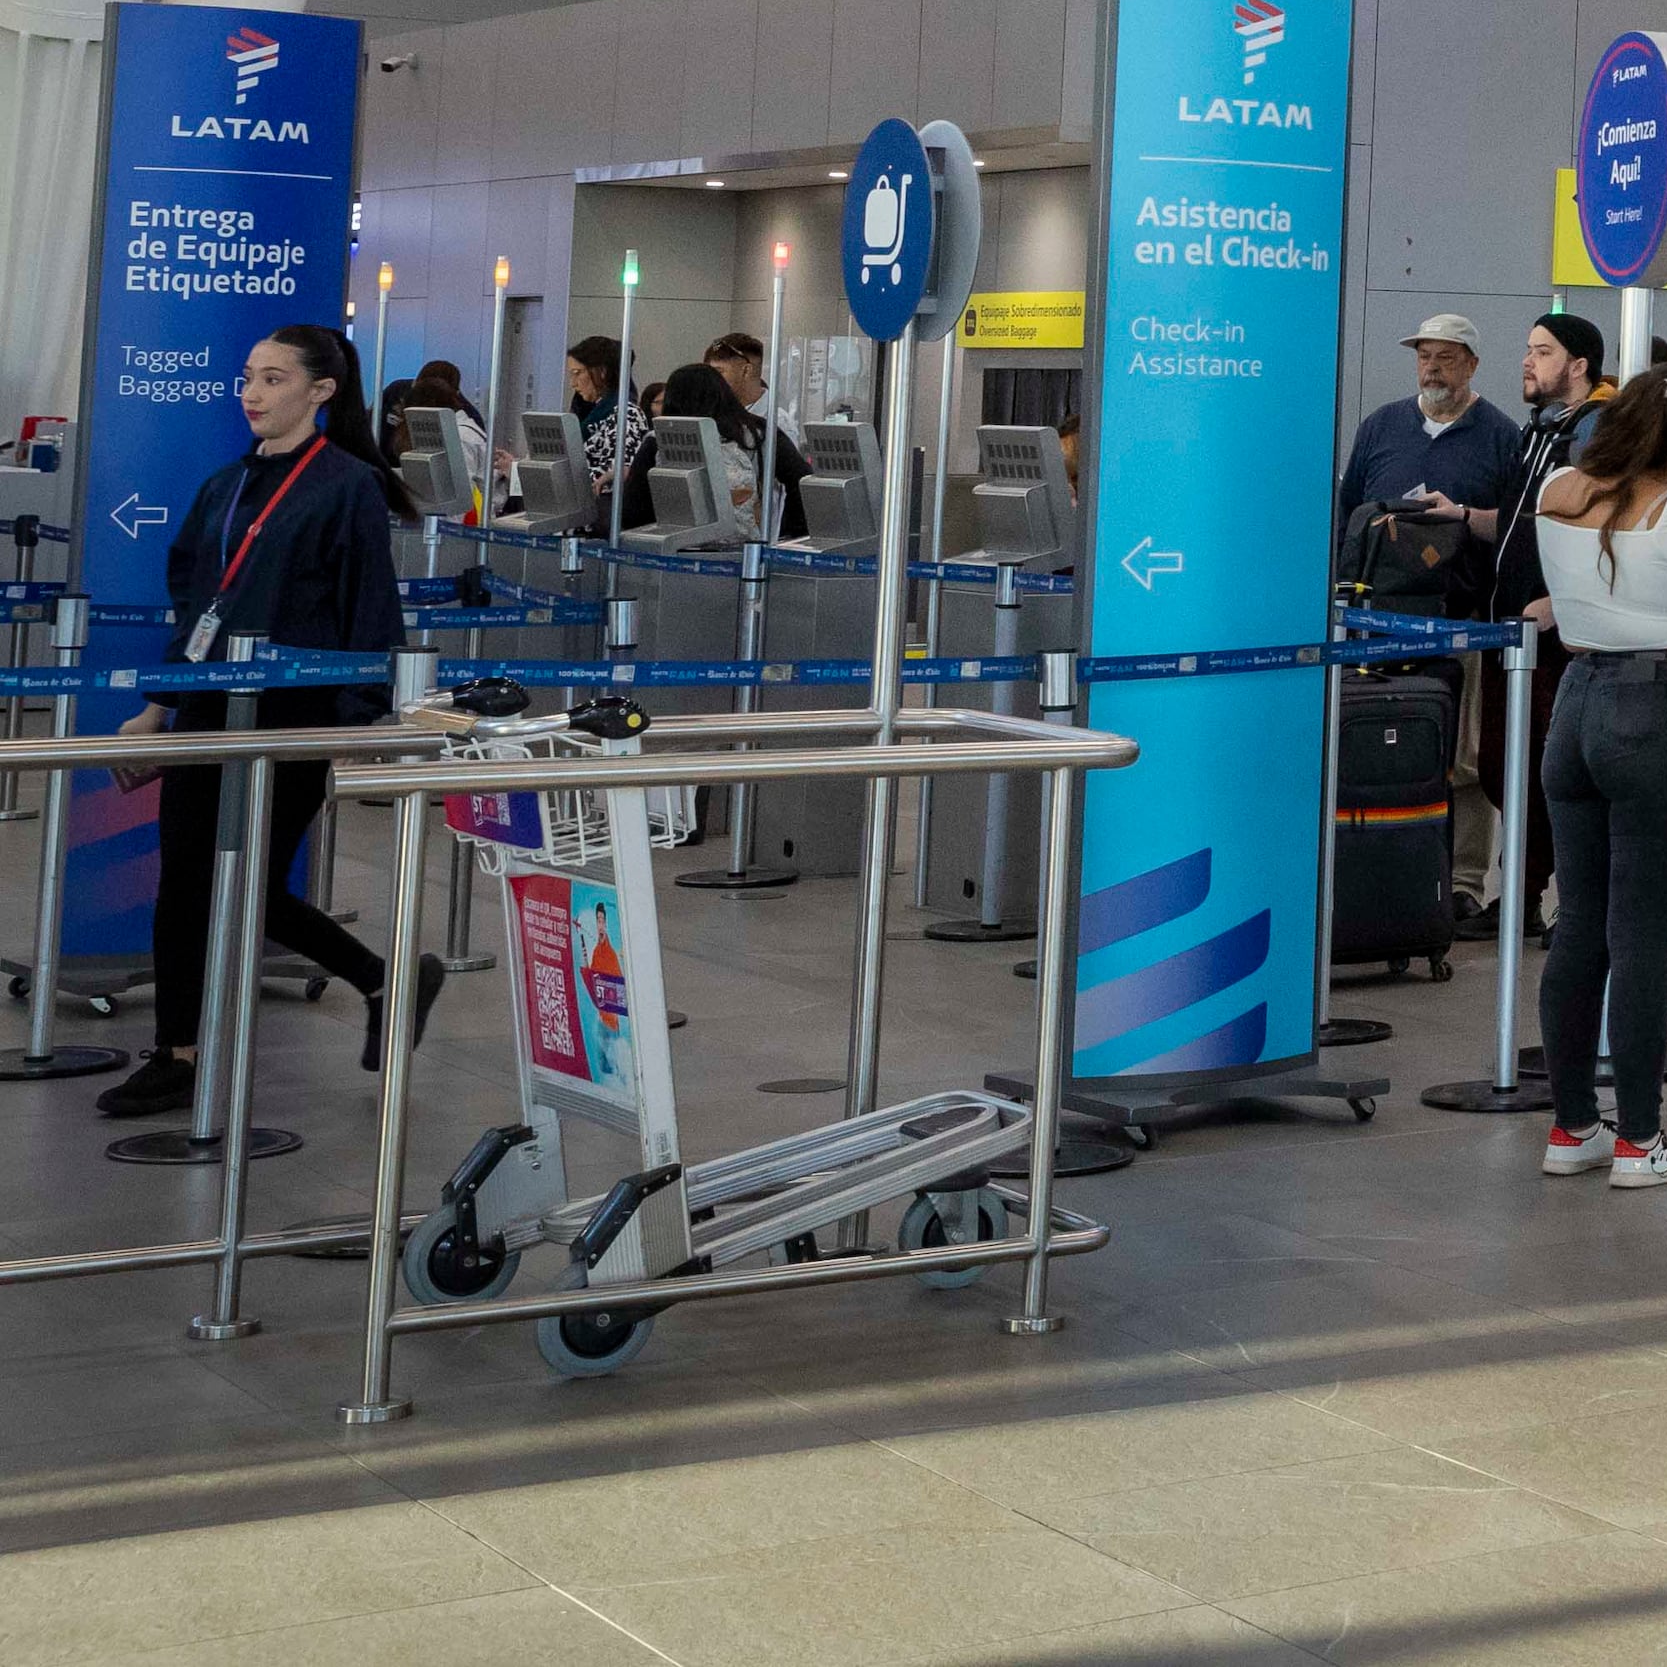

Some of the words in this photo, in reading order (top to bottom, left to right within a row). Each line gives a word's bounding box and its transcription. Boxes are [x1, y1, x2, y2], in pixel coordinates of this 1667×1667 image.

[1618, 64, 1648, 82] LATAM
[1178, 96, 1313, 131] LATAM
[171, 115, 309, 144] LATAM
[1597, 119, 1656, 155] ¡Comienza
[1610, 156, 1641, 191] Aquí!
[129, 201, 254, 237] Entrega
[1135, 195, 1291, 232] Asistencia
[127, 232, 166, 260] de
[177, 235, 305, 271] Equipaje
[1135, 239, 1175, 265] en
[1185, 234, 1212, 266] el
[1222, 236, 1329, 272] Check-in
[126, 265, 296, 300] Etiquetado
[1131, 316, 1245, 343] Check-in
[121, 345, 210, 373] Tagged
[1128, 352, 1263, 377] Assistance
[119, 374, 225, 402] Baggage
[22, 677, 49, 687] Banco
[50, 678, 59, 687] de
[61, 676, 83, 687] Chile
[162, 673, 195, 683] FAN
[208, 671, 234, 682] Banco
[236, 671, 243, 680] de
[246, 670, 266, 681] Chile
[525, 669, 553, 679] FAN
